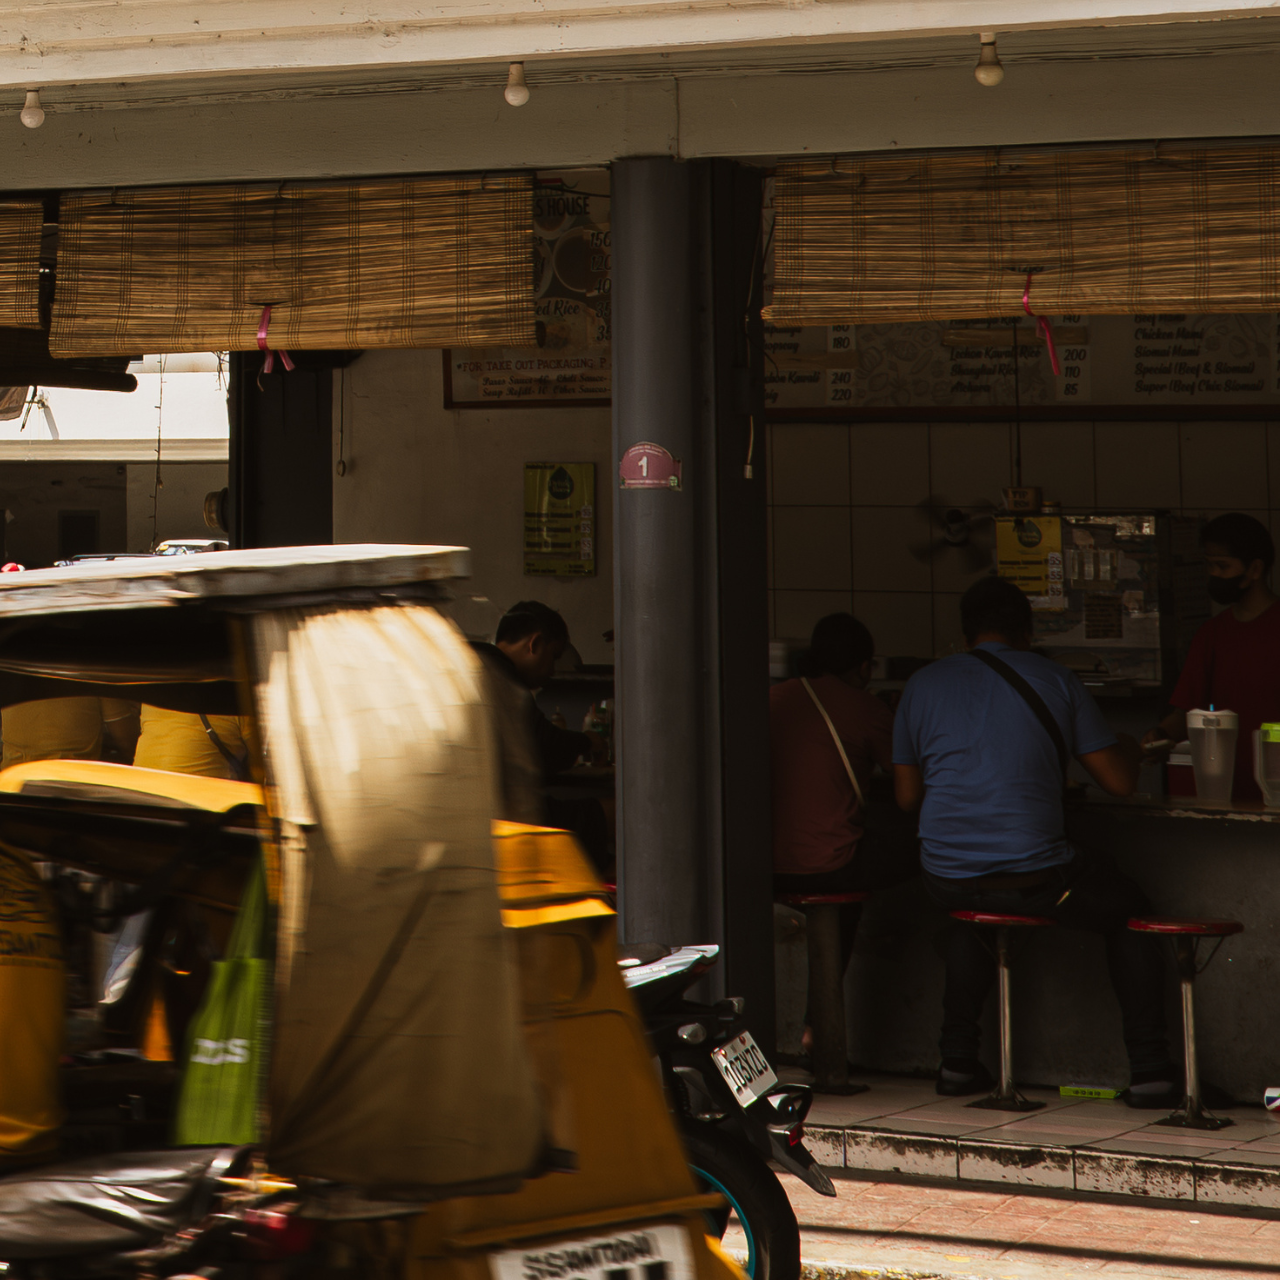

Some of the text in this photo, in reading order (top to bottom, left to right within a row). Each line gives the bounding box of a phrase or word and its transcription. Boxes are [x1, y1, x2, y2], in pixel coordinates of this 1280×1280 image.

[547, 197, 590, 217] HOUSE
[554, 300, 580, 317] Rice
[832, 336, 850, 349] 180
[1064, 348, 1086, 361] 200
[487, 361, 512, 371] TAKE
[515, 361, 534, 370] OUT
[1064, 366, 1080, 378] 110
[831, 372, 851, 384] 240
[831, 388, 852, 401] 220
[1064, 383, 1078, 396] 85
[637, 455, 648, 477] 1
